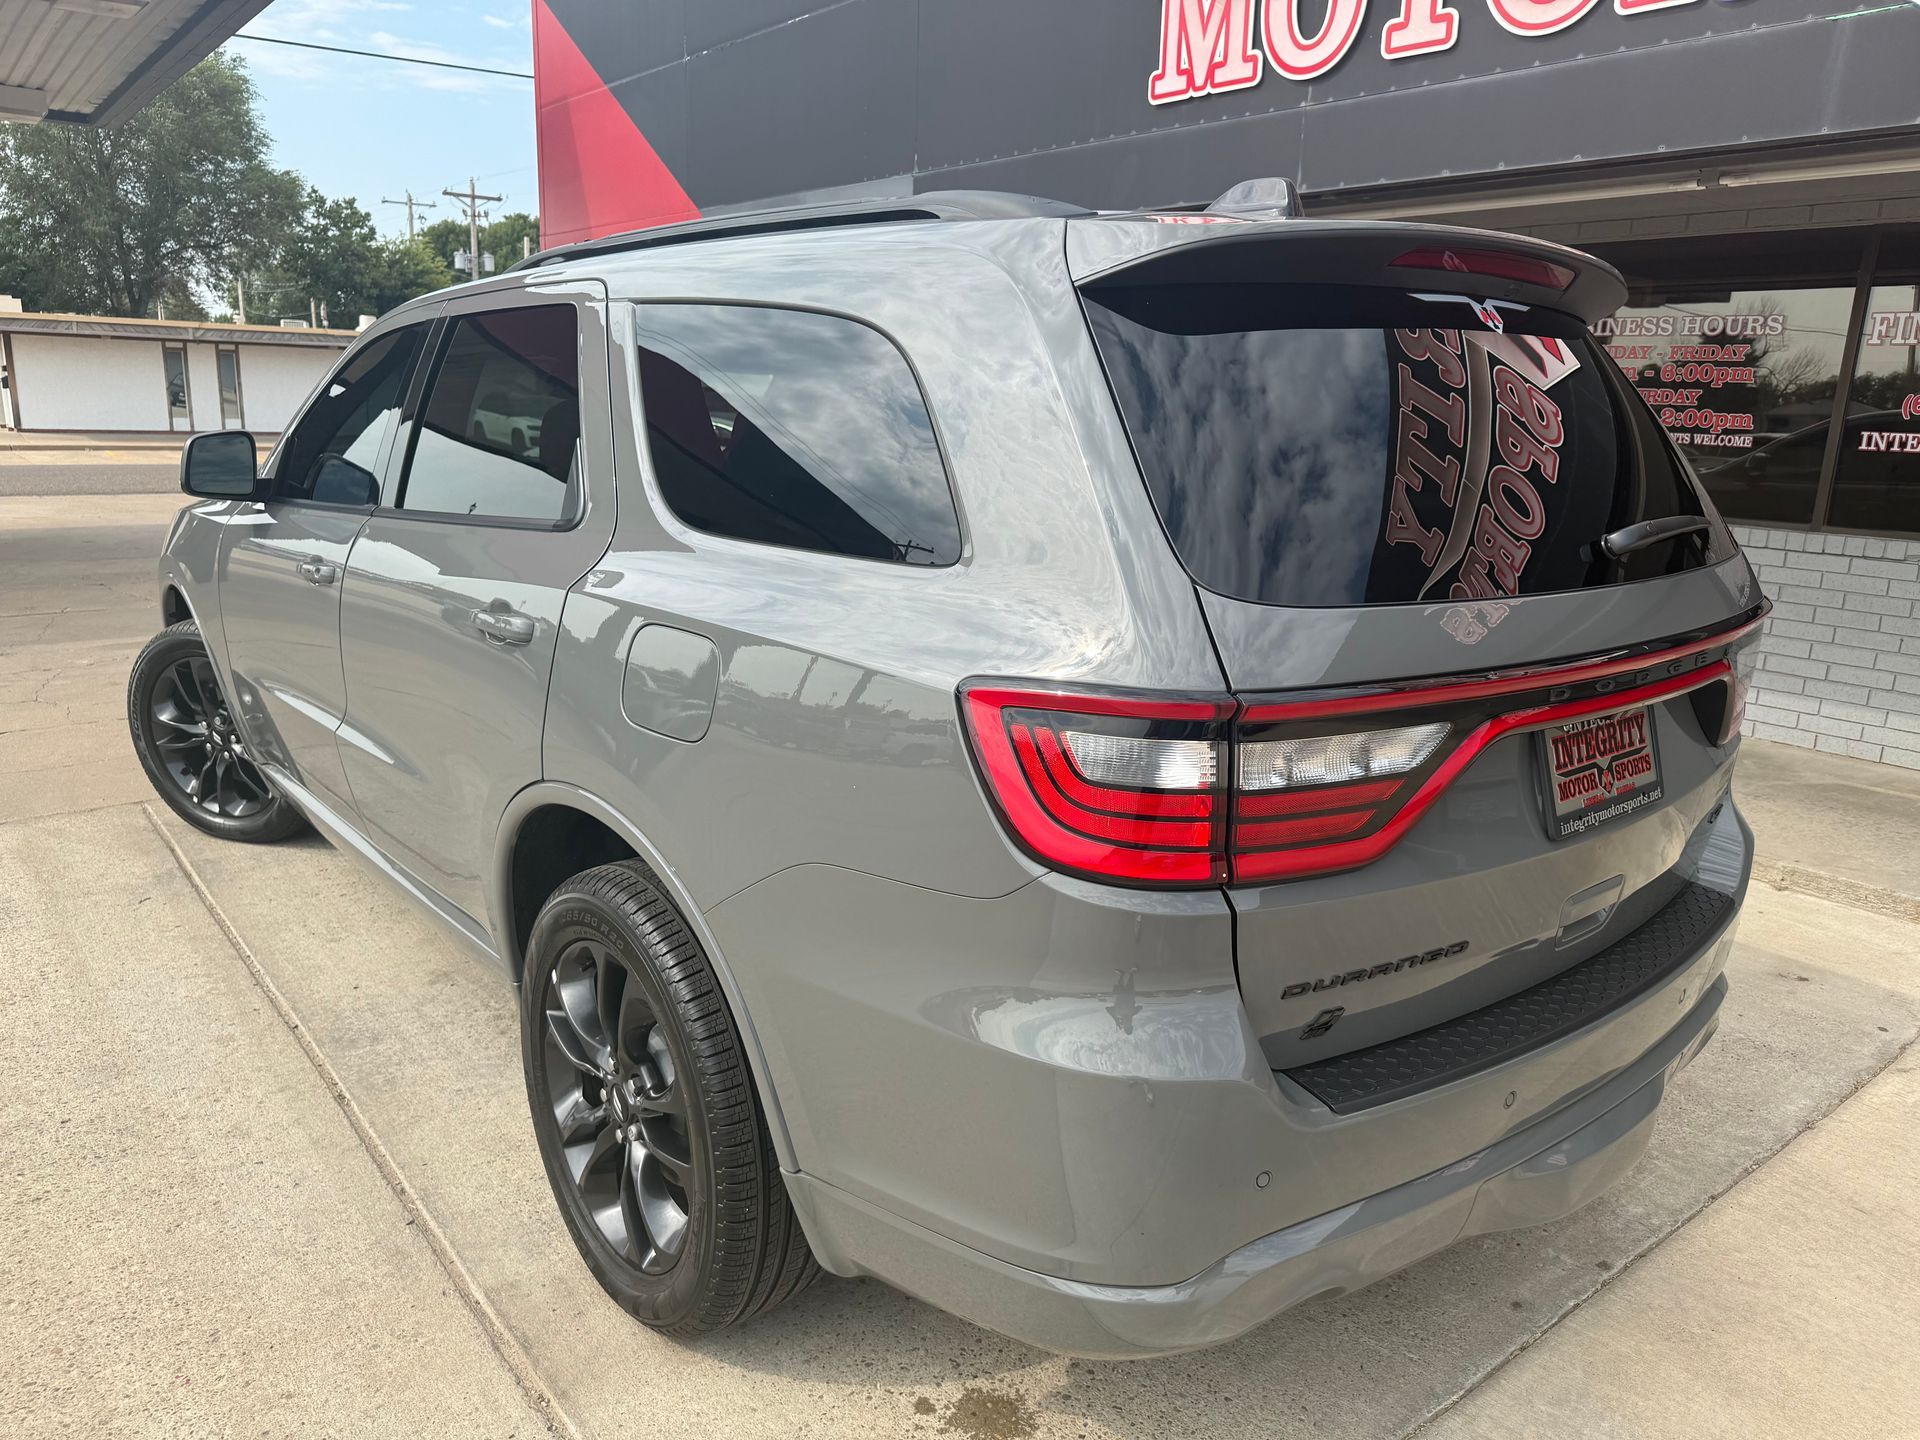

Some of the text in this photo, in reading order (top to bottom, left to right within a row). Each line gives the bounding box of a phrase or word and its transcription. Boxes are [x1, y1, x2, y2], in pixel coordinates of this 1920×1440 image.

[1680, 315, 1784, 337] HOURS
[1867, 312, 1920, 346] FI
[1668, 344, 1751, 361] FRIDAY
[1660, 363, 1754, 387] 6:00pm
[1660, 408, 1753, 433] 2:00pm
[1693, 433, 1753, 448] WELCOME
[1858, 431, 1920, 452] INTE
[1550, 648, 1709, 701] DODGE
[1551, 713, 1646, 772] INTEGRITY
[1557, 771, 1599, 803] MOTOR
[1613, 753, 1652, 782] SPORTS
[1560, 787, 1662, 835] integritymotorsports.net
[1280, 940, 1469, 1000] DURANGO
